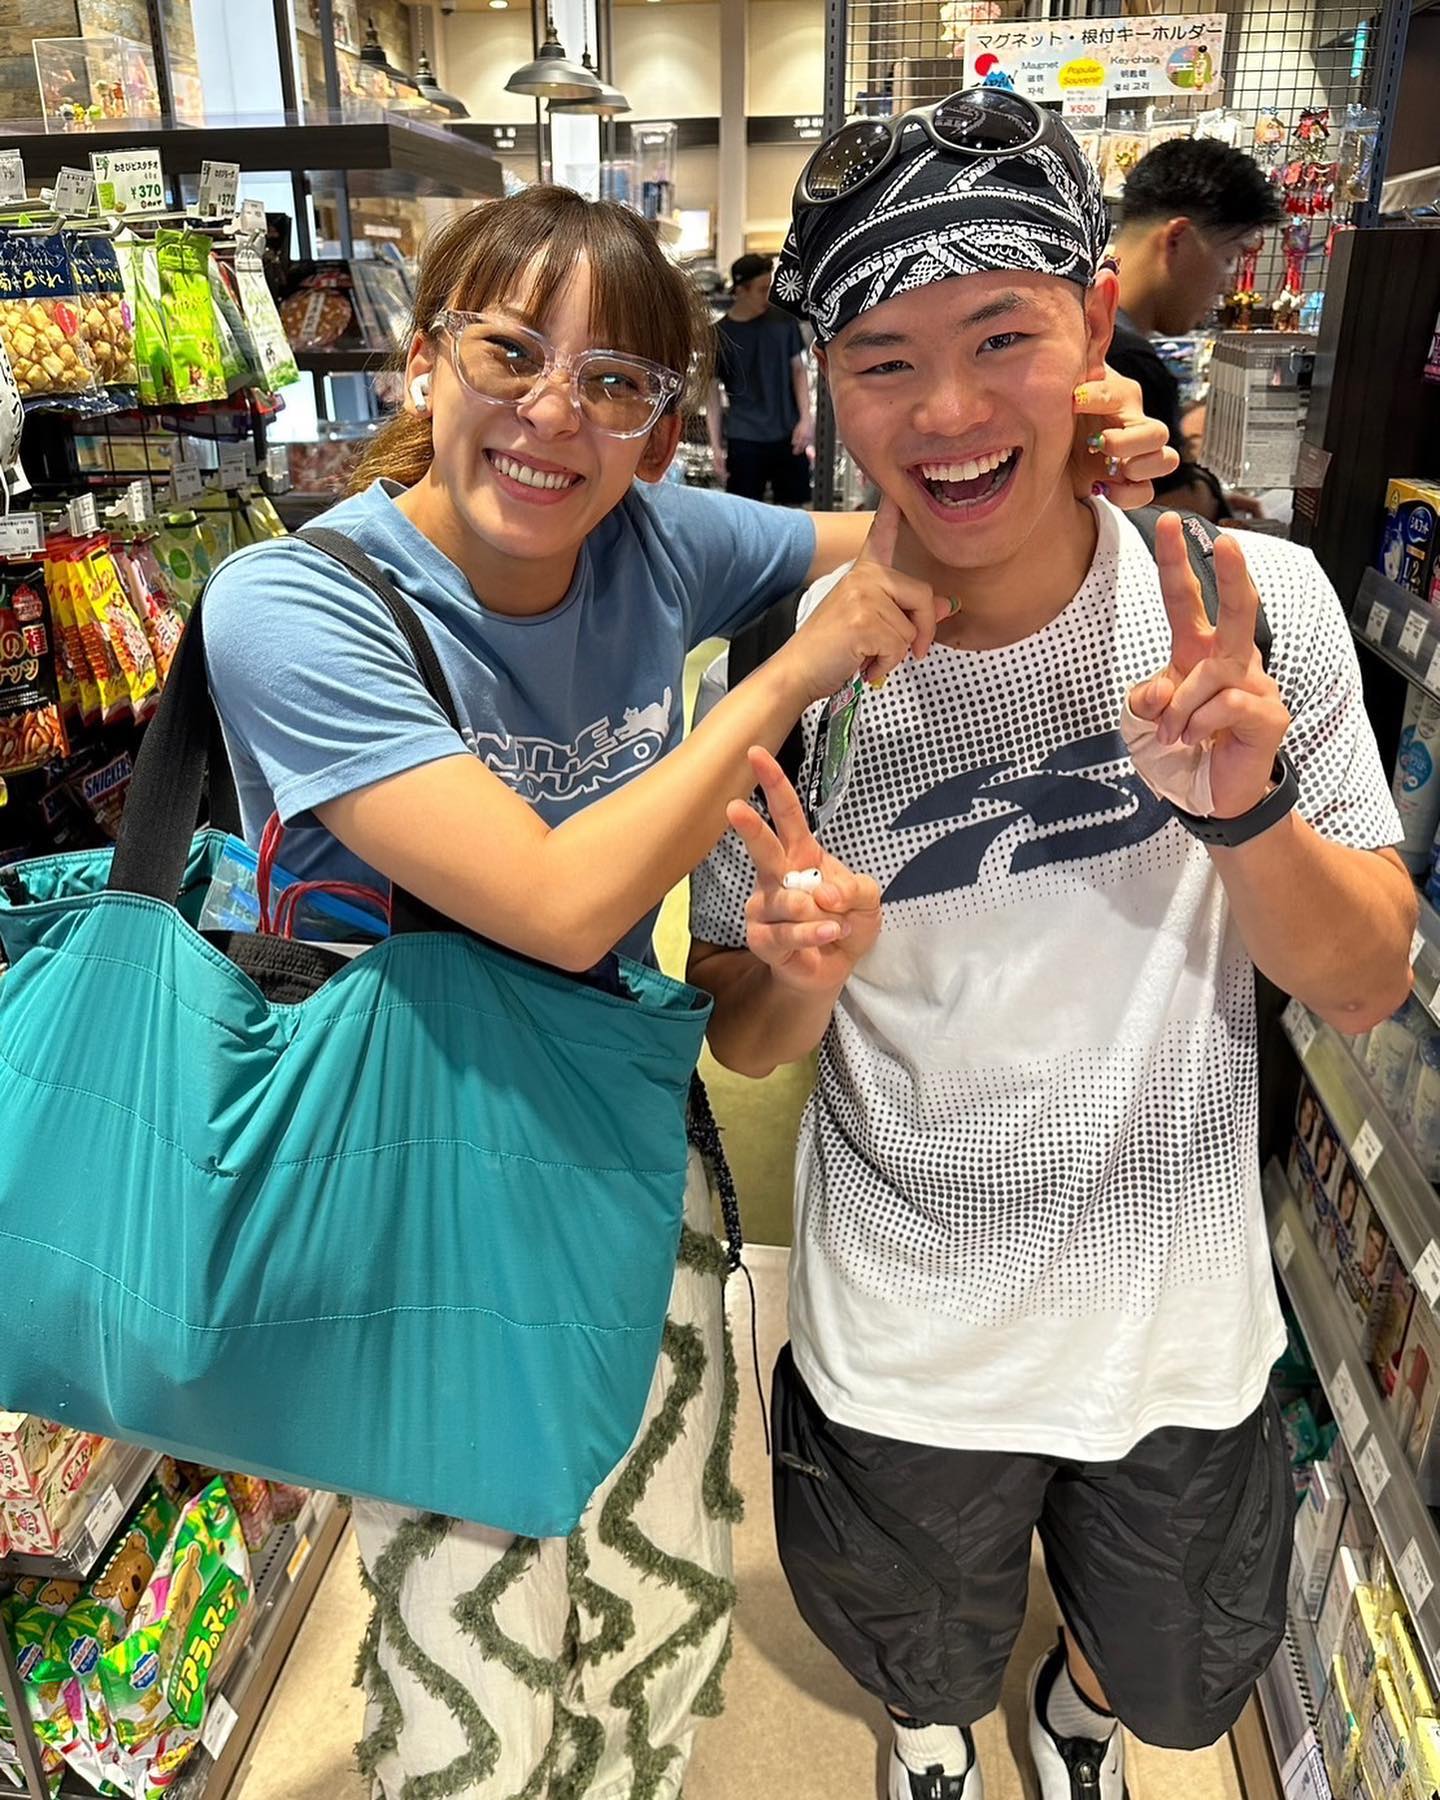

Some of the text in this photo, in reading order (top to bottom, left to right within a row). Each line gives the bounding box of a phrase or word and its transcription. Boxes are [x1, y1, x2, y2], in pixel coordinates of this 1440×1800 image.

[977, 23, 1222, 49] マグネット・根付キーホルダー
[1022, 61, 1059, 69] Magnet
[1067, 66, 1100, 75] Popular
[1070, 104, 1096, 113] ¥500
[130, 184, 161, 199] ¥370
[0, 623, 48, 659] の種
[176, 1578, 236, 1713] コアラのマーチ
